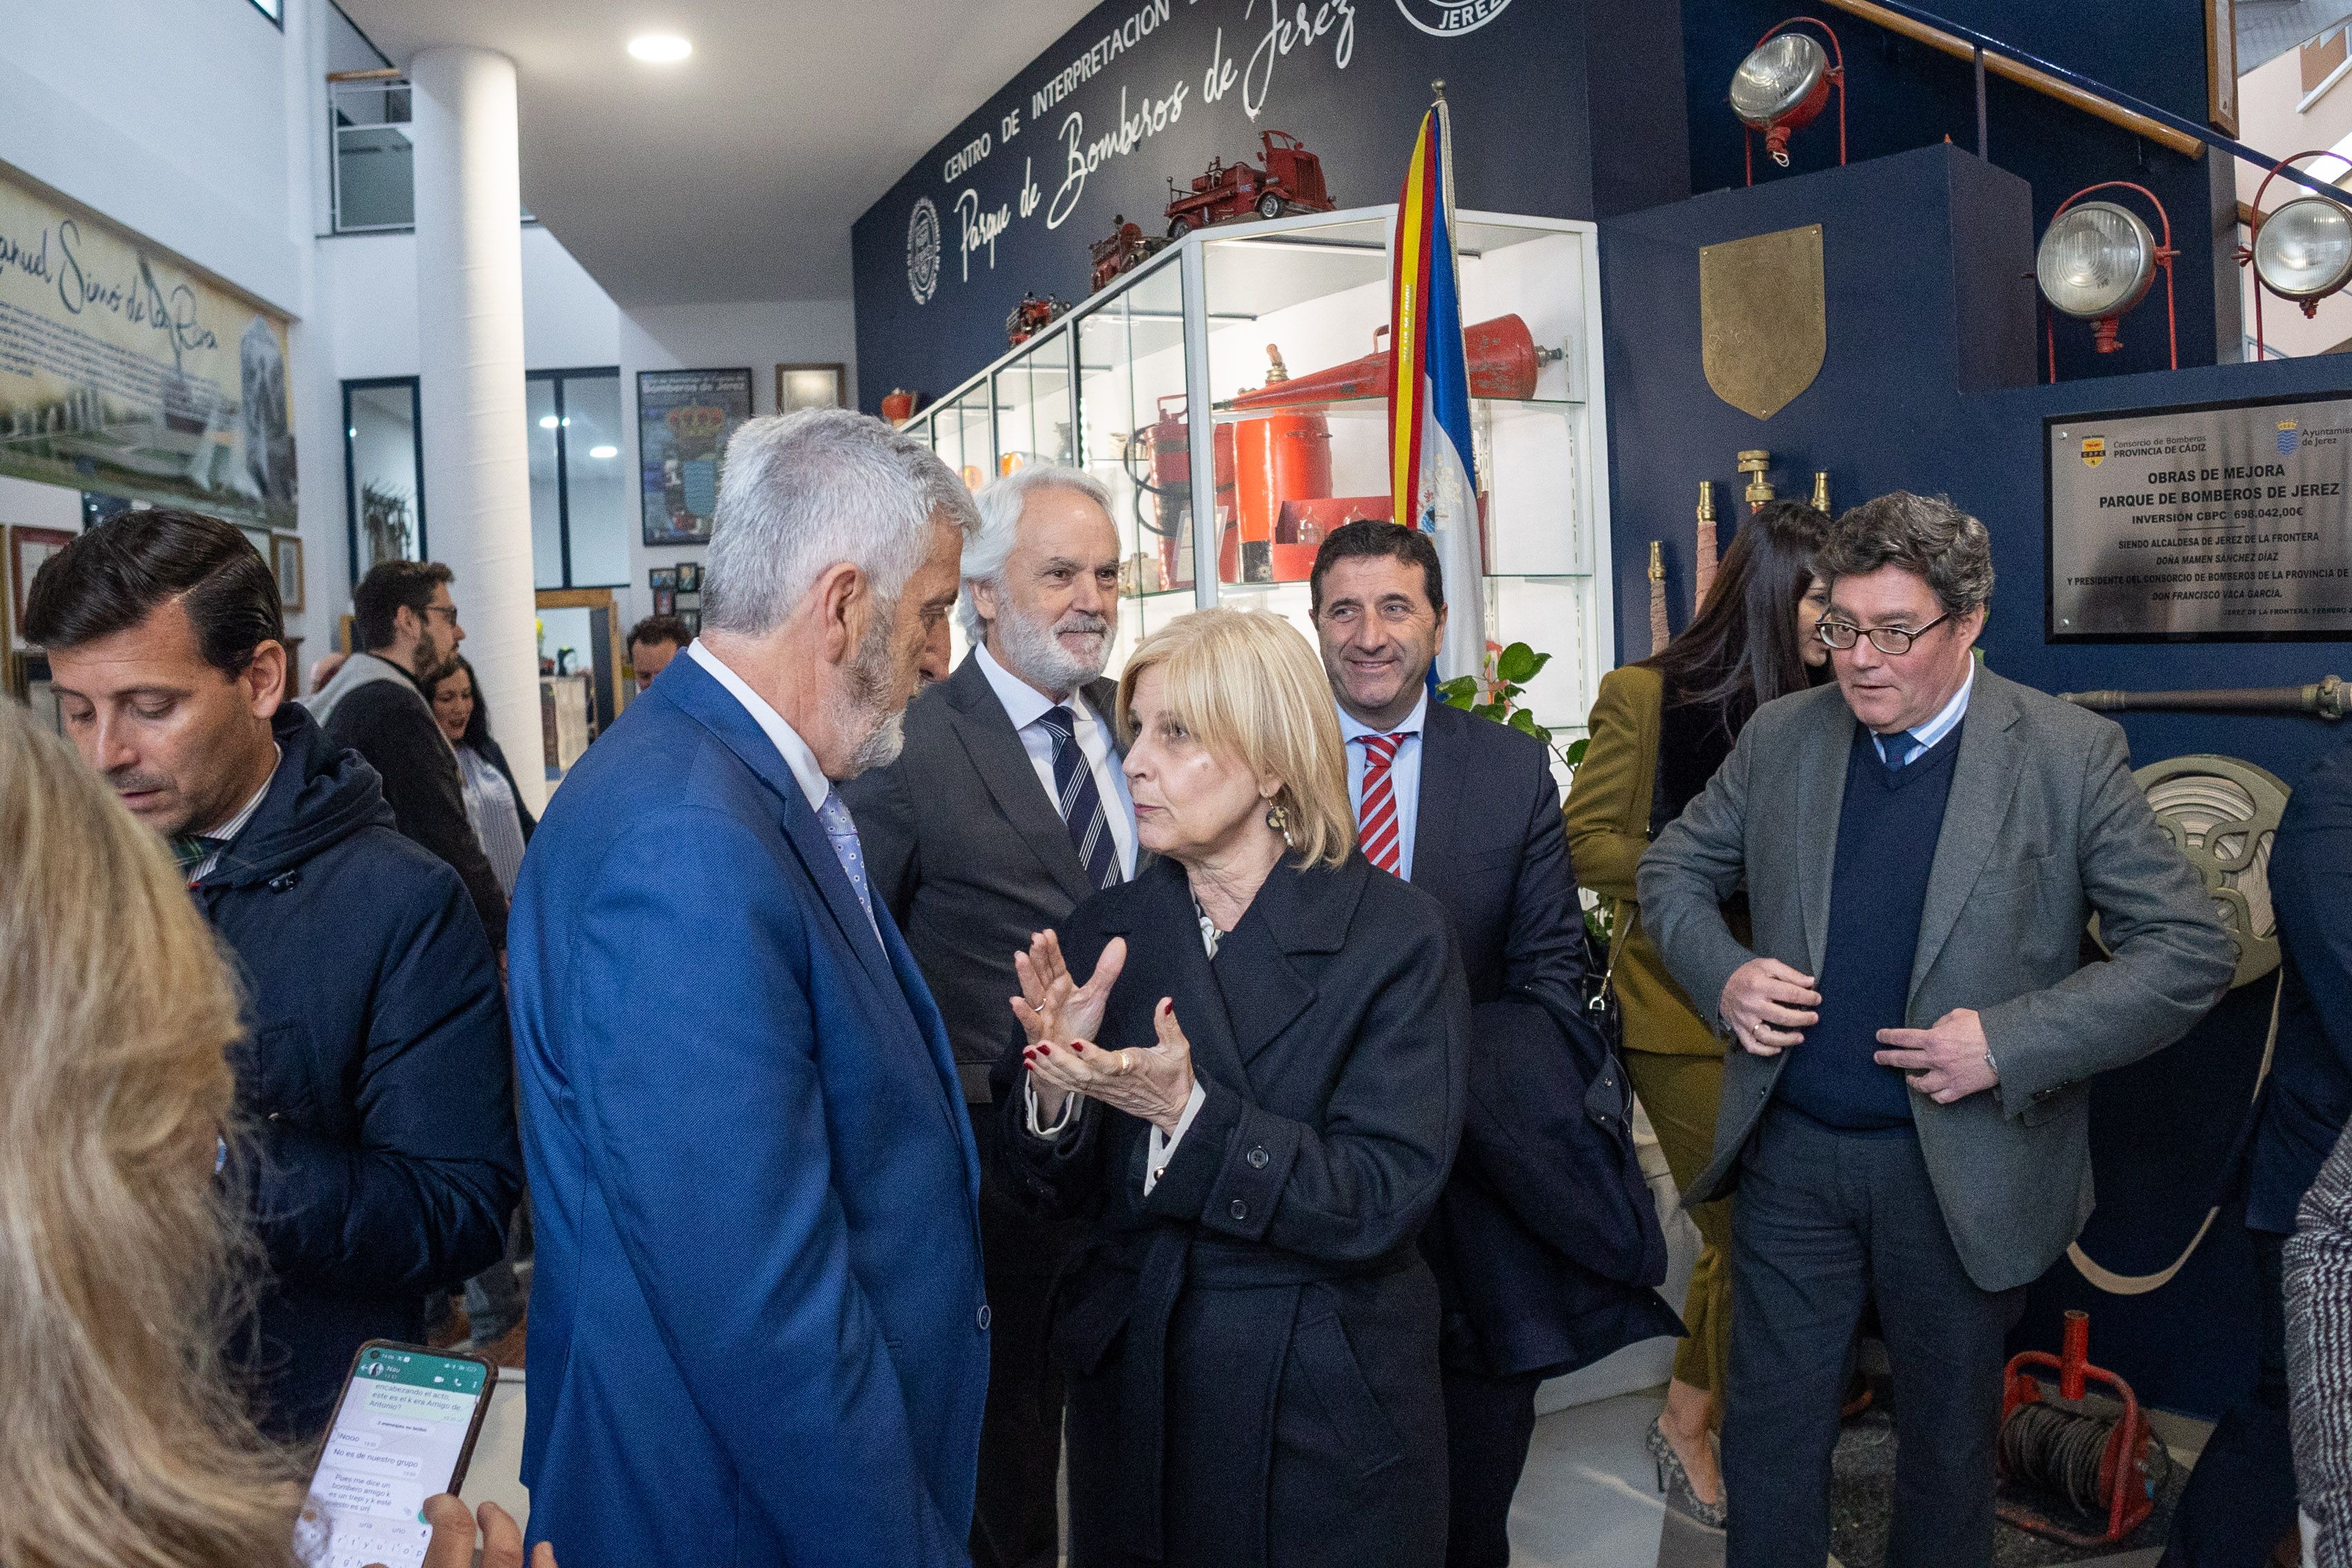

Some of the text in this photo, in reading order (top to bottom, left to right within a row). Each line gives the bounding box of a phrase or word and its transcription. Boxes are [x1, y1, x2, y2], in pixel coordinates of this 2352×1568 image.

[944, 133, 991, 184] CENTRO
[1002, 108, 1021, 144] DE
[953, 188, 1011, 283] Parque
[1020, 156, 1041, 219] de
[1047, 80, 1190, 231] Bomberos
[1204, 27, 1238, 104] de
[1243, 0, 1355, 123] Jerez
[0, 228, 52, 284] anuel
[2113, 435, 2206, 449] Consorcio de Bomberos
[2113, 442, 2206, 458] PROVINCIA DE CÁDIZ
[2302, 437, 2337, 447] de Jerez
[2148, 464, 2286, 484] OBRAS DE MEJORA
[2099, 482, 2340, 508] PARQUE DE BOMBEROS DE JEREZ
[2132, 507, 2304, 525] INVERSIÓN CBPC 698.042,00€
[2118, 532, 2319, 549] SIENDO ALCALDESA DE JEREZ DE LA FRONTERA
[2156, 554, 2179, 565] DOÑA
[2182, 554, 2213, 565] MAMEN
[2067, 568, 2349, 587] Y PRESIDENTE DEL CONSORCIO DE BOMBEROS DE LA PROVINCIA DE
[2152, 591, 2170, 601] DON
[2172, 590, 2220, 600] FRANCISCO
[2223, 589, 2245, 599] VACA
[375, 1384, 423, 1396] encabezando
[369, 1400, 402, 1411] Antonio?
[427, 1400, 449, 1411] Amigo
[367, 1455, 395, 1464] nuestro
[396, 1458, 418, 1469] grupo
[335, 1474, 352, 1483] Pues
[332, 1482, 362, 1493] bombero
[364, 1488, 385, 1498] amigo
